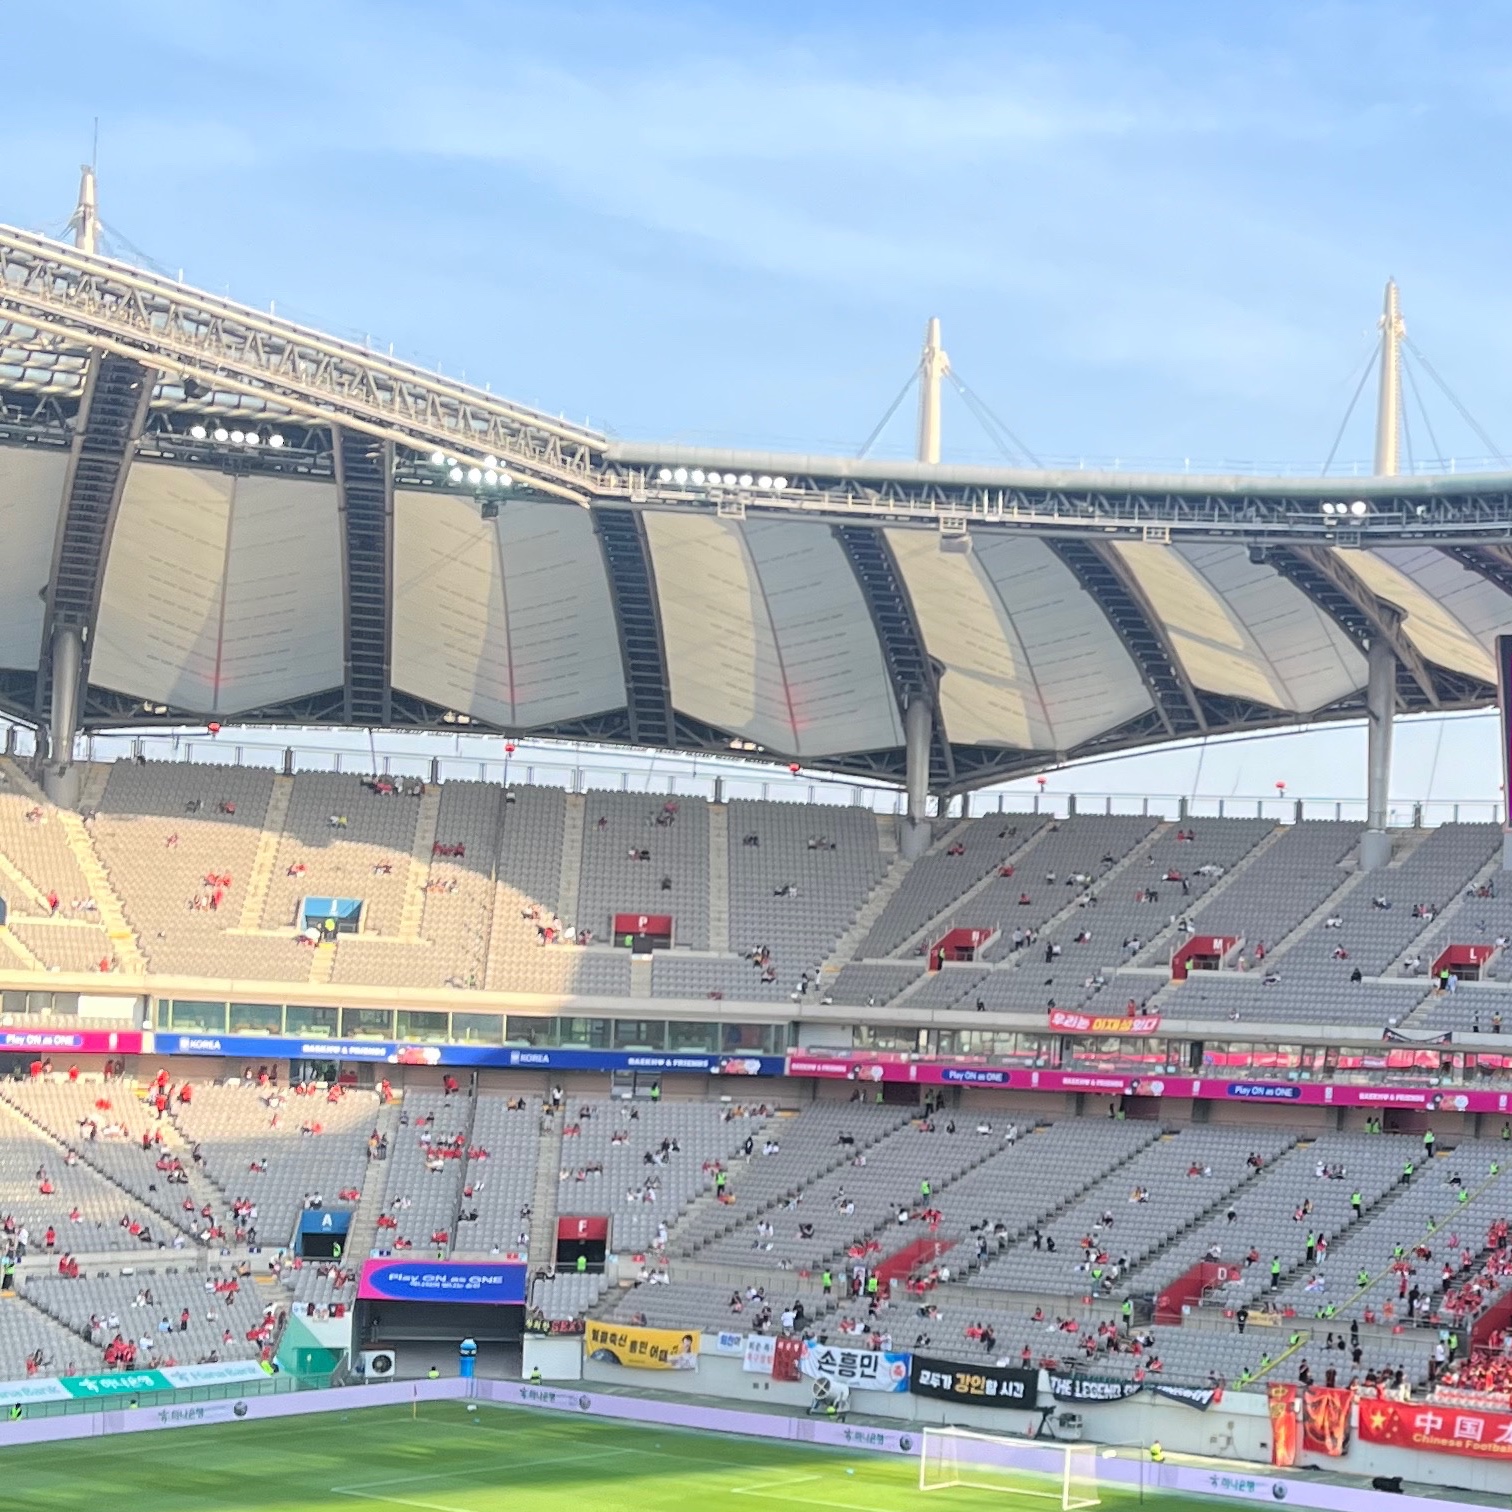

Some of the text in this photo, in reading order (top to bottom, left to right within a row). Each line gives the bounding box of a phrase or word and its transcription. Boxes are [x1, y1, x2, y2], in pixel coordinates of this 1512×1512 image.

[520, 1053, 550, 1063] KOREA
[1234, 1085, 1251, 1097] Play
[1251, 1086, 1265, 1096] ON
[1274, 1087, 1293, 1097] ONE
[321, 1213, 333, 1227] A
[578, 1220, 588, 1234] F
[388, 1273, 420, 1283] Play
[422, 1274, 447, 1283] ON
[468, 1276, 504, 1285] ONE
[1217, 1267, 1227, 1281] D
[817, 1349, 879, 1380] 손흥민
[919, 1369, 953, 1391] 모두가
[999, 1381, 1025, 1399] 시간
[1050, 1376, 1072, 1396] THE
[1074, 1379, 1122, 1400] LEGEND
[1412, 1432, 1463, 1448] Chinese
[1221, 1477, 1256, 1493] 하나은행
